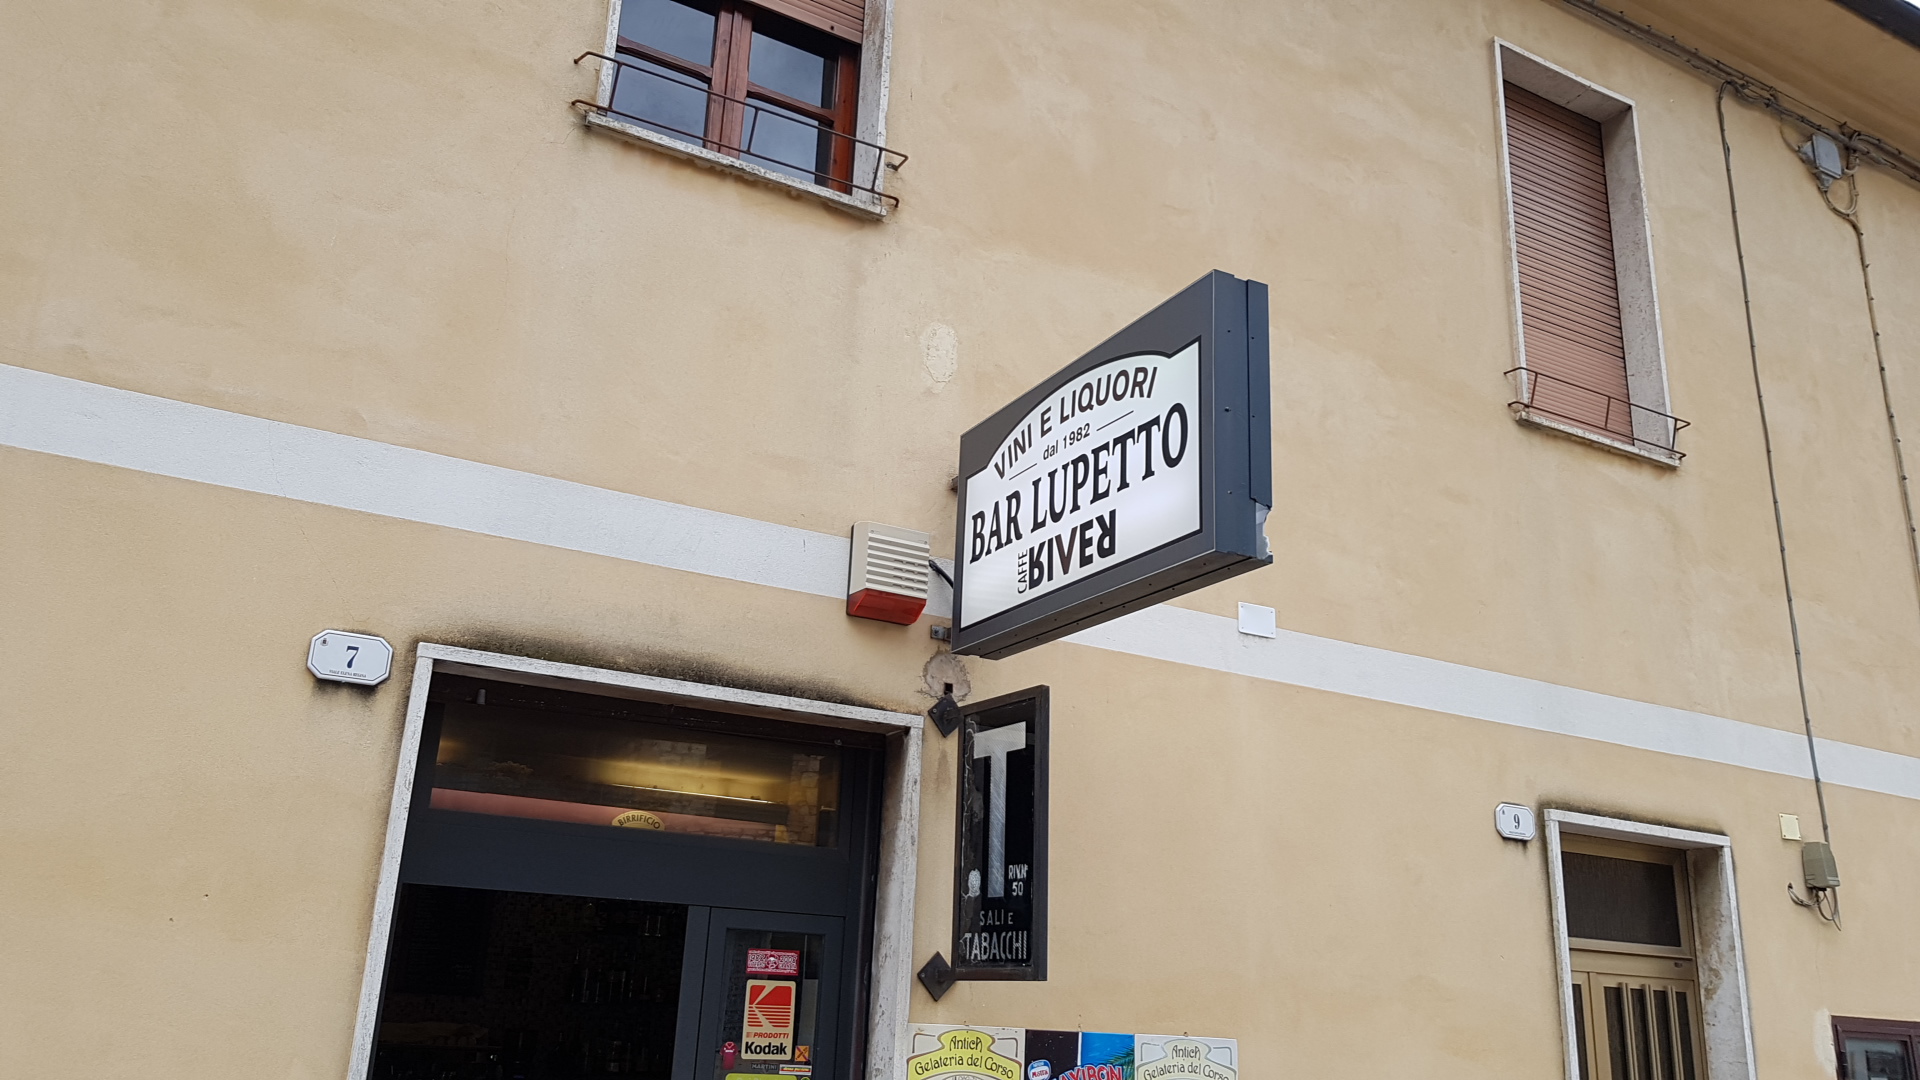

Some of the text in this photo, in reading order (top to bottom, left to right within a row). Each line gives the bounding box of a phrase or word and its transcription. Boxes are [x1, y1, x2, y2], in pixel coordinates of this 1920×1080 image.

[993, 366, 1158, 480] VINI E LIQUORI
[1043, 423, 1091, 461] dal 1982
[970, 402, 1189, 564] BAR LUPETTO
[1028, 509, 1117, 590] RIVER
[1017, 549, 1028, 594] CAFFE
[346, 645, 360, 669] 7
[617, 814, 661, 829] BIRRIFICIO
[973, 721, 1026, 898] T
[1513, 813, 1520, 830] 9
[1011, 881, 1024, 896] 50
[979, 908, 1014, 926] SALI E
[963, 930, 1027, 961] TABACCHI
[744, 1041, 787, 1055] Kodak
[751, 1063, 777, 1071] MARTINI
[914, 1053, 1014, 1079] Gelateria del Corso
[1143, 1061, 1185, 1080] Gelateria
[1187, 1061, 1202, 1076] del
